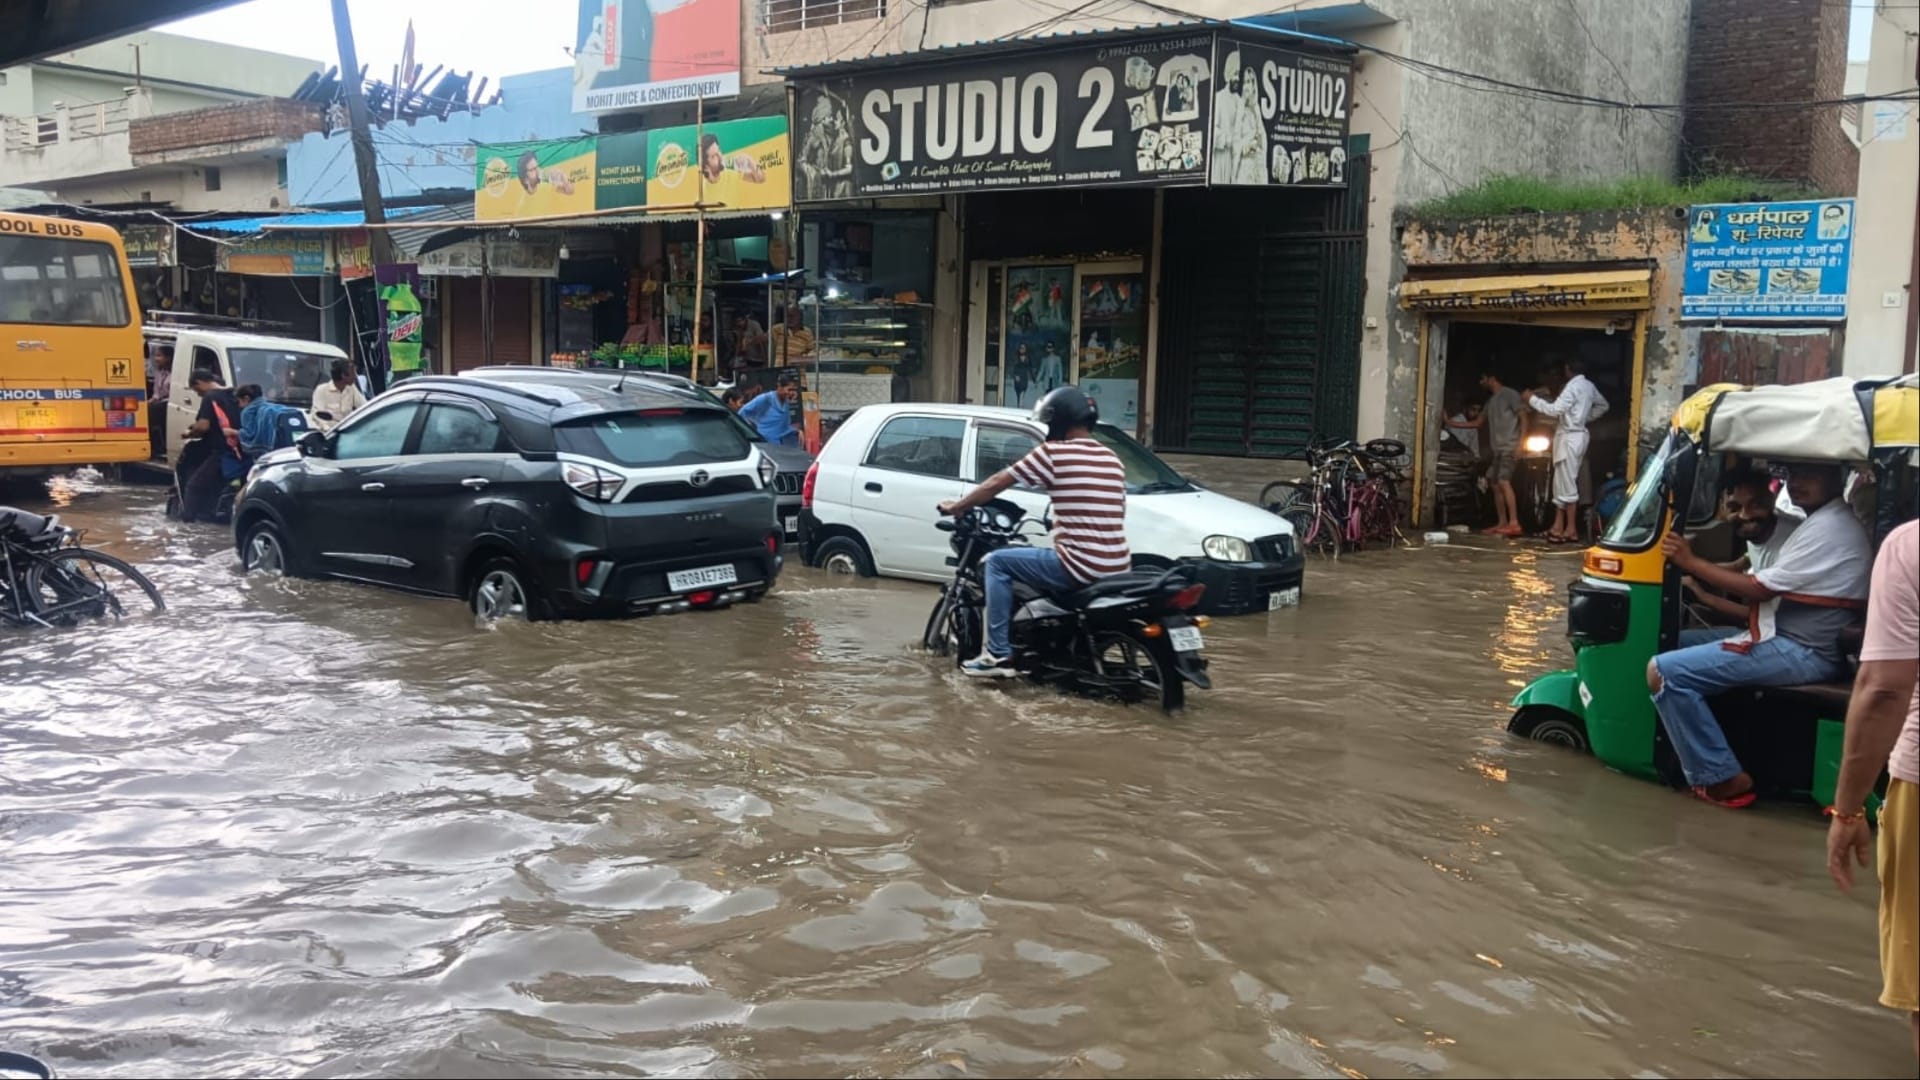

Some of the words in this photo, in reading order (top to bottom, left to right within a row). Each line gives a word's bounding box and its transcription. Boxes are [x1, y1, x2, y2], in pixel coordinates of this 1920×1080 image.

[586, 94, 613, 108] MOHIT
[615, 91, 638, 106] JUICE
[640, 90, 647, 103] &
[649, 80, 721, 101] CONFECTIONERY
[860, 72, 1058, 165] STUDIO
[1076, 66, 1115, 149] 2
[911, 165, 918, 177] A
[921, 165, 949, 178] Complete
[953, 164, 969, 174] Unit
[971, 162, 983, 173] Of
[1010, 159, 1052, 172] Photography
[1728, 206, 1812, 225] धर्मपाल
[45, 223, 84, 237] BUS
[1736, 247, 1750, 255] पर
[0, 389, 45, 400] HOOL
[54, 389, 82, 400] BUS
